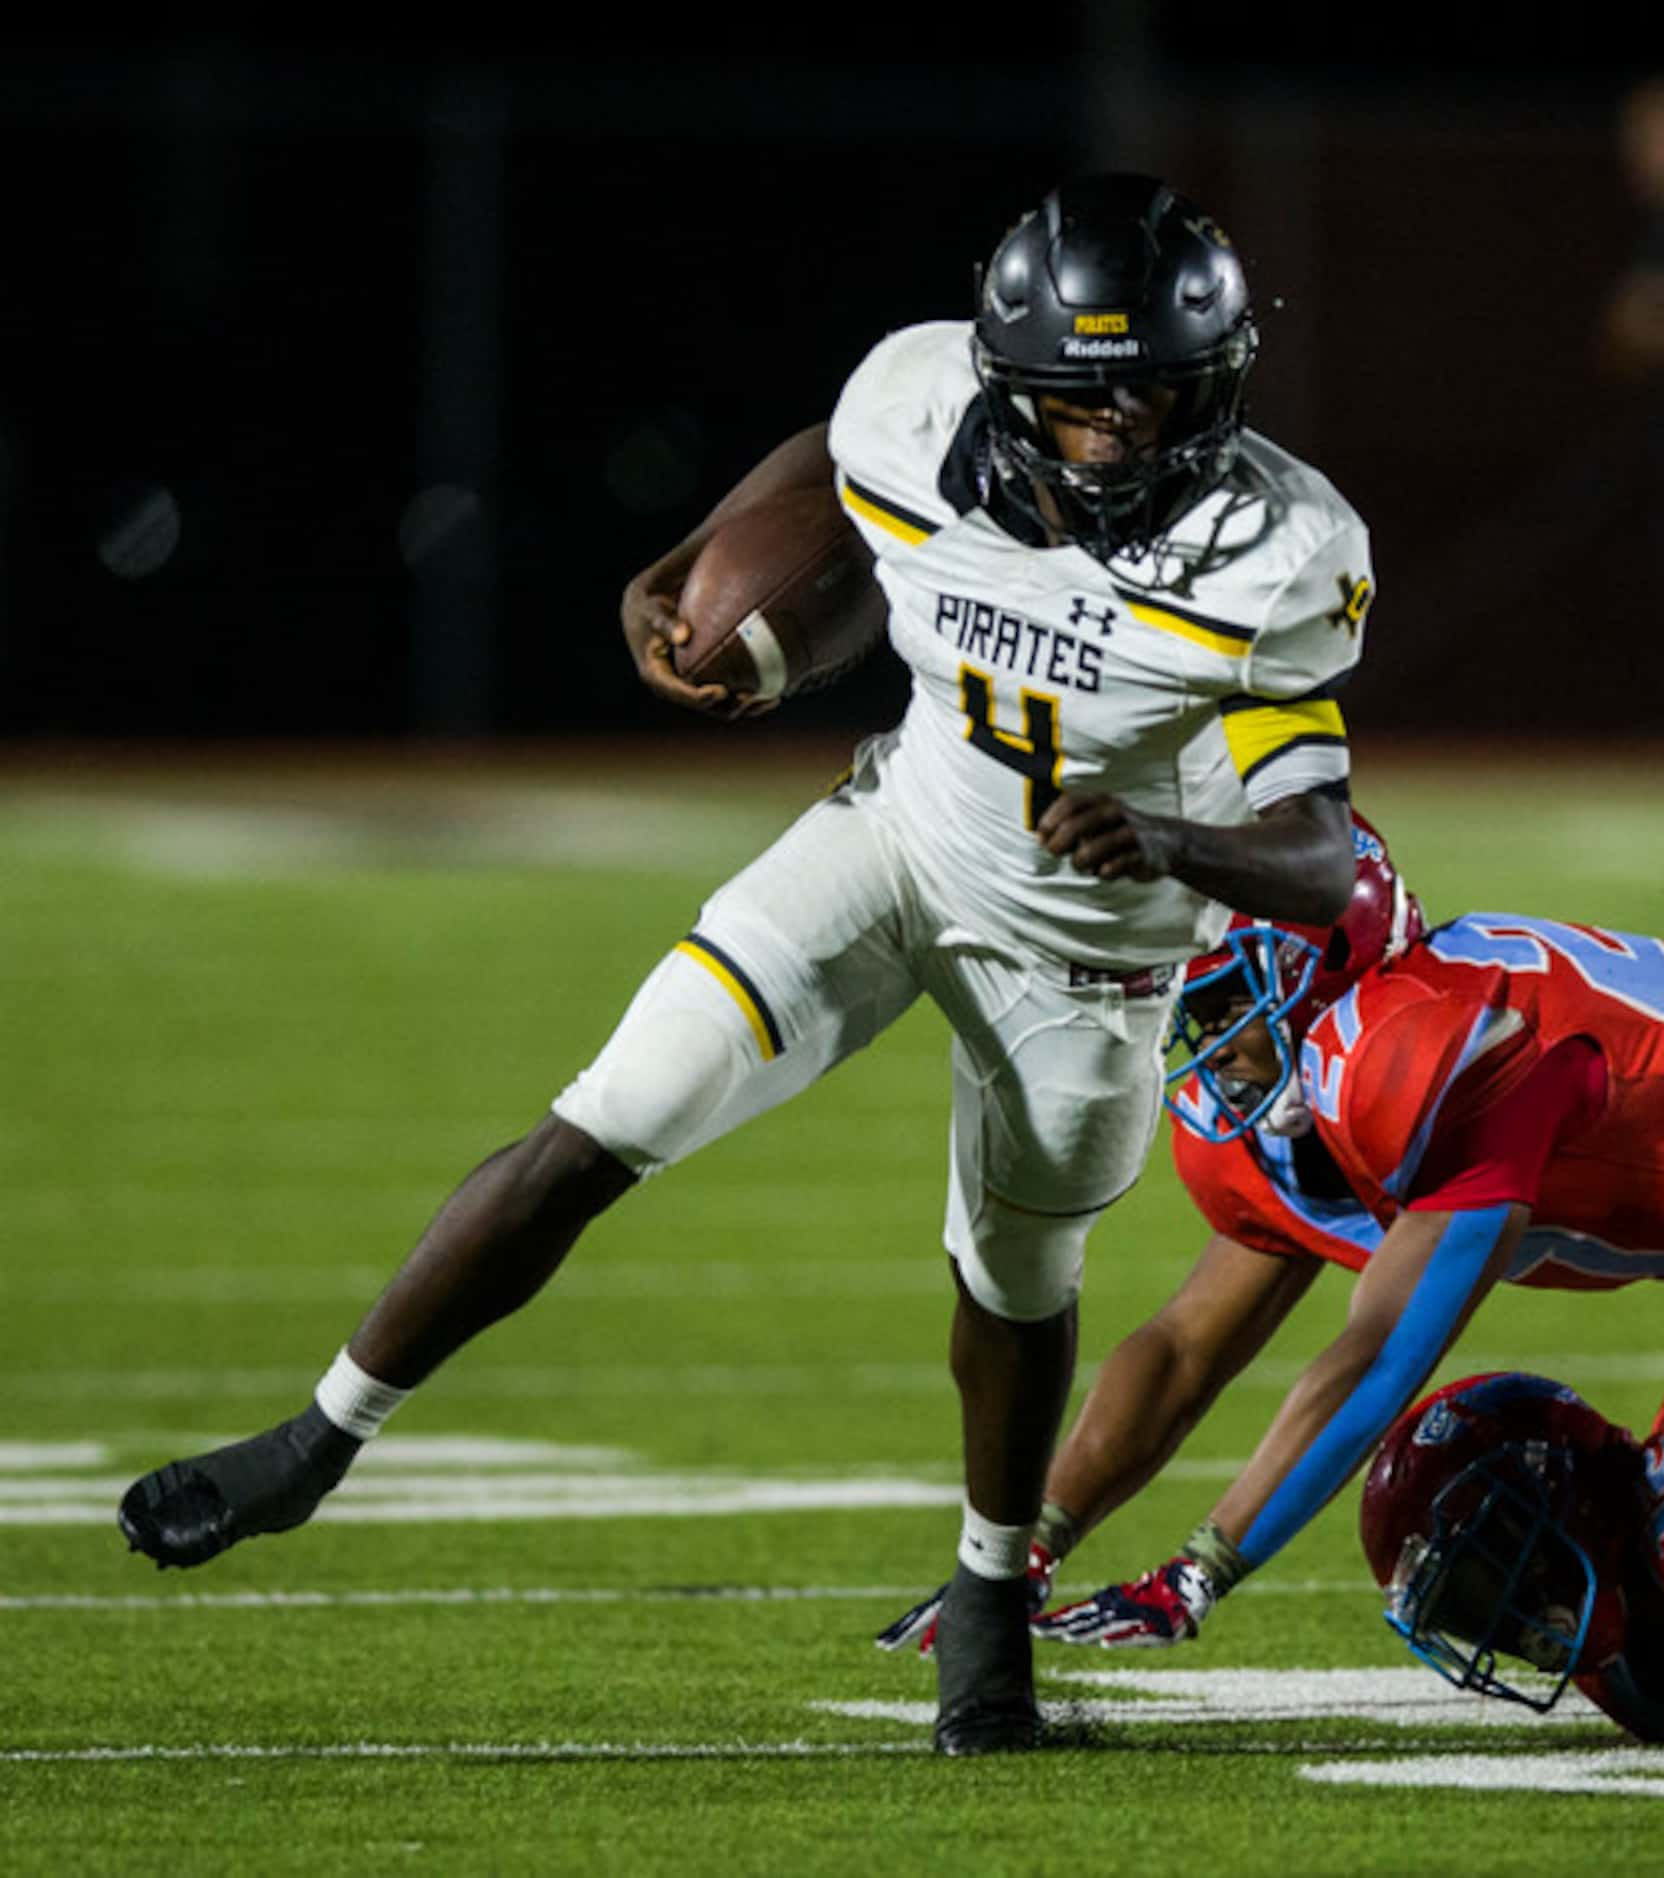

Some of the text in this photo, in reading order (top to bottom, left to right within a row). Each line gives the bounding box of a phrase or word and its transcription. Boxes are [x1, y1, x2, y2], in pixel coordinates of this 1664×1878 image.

[1063, 338, 1139, 358] Riddell
[936, 594, 1102, 693] PIRATES
[960, 661, 1065, 832] 4
[1299, 981, 1365, 1124] 27
